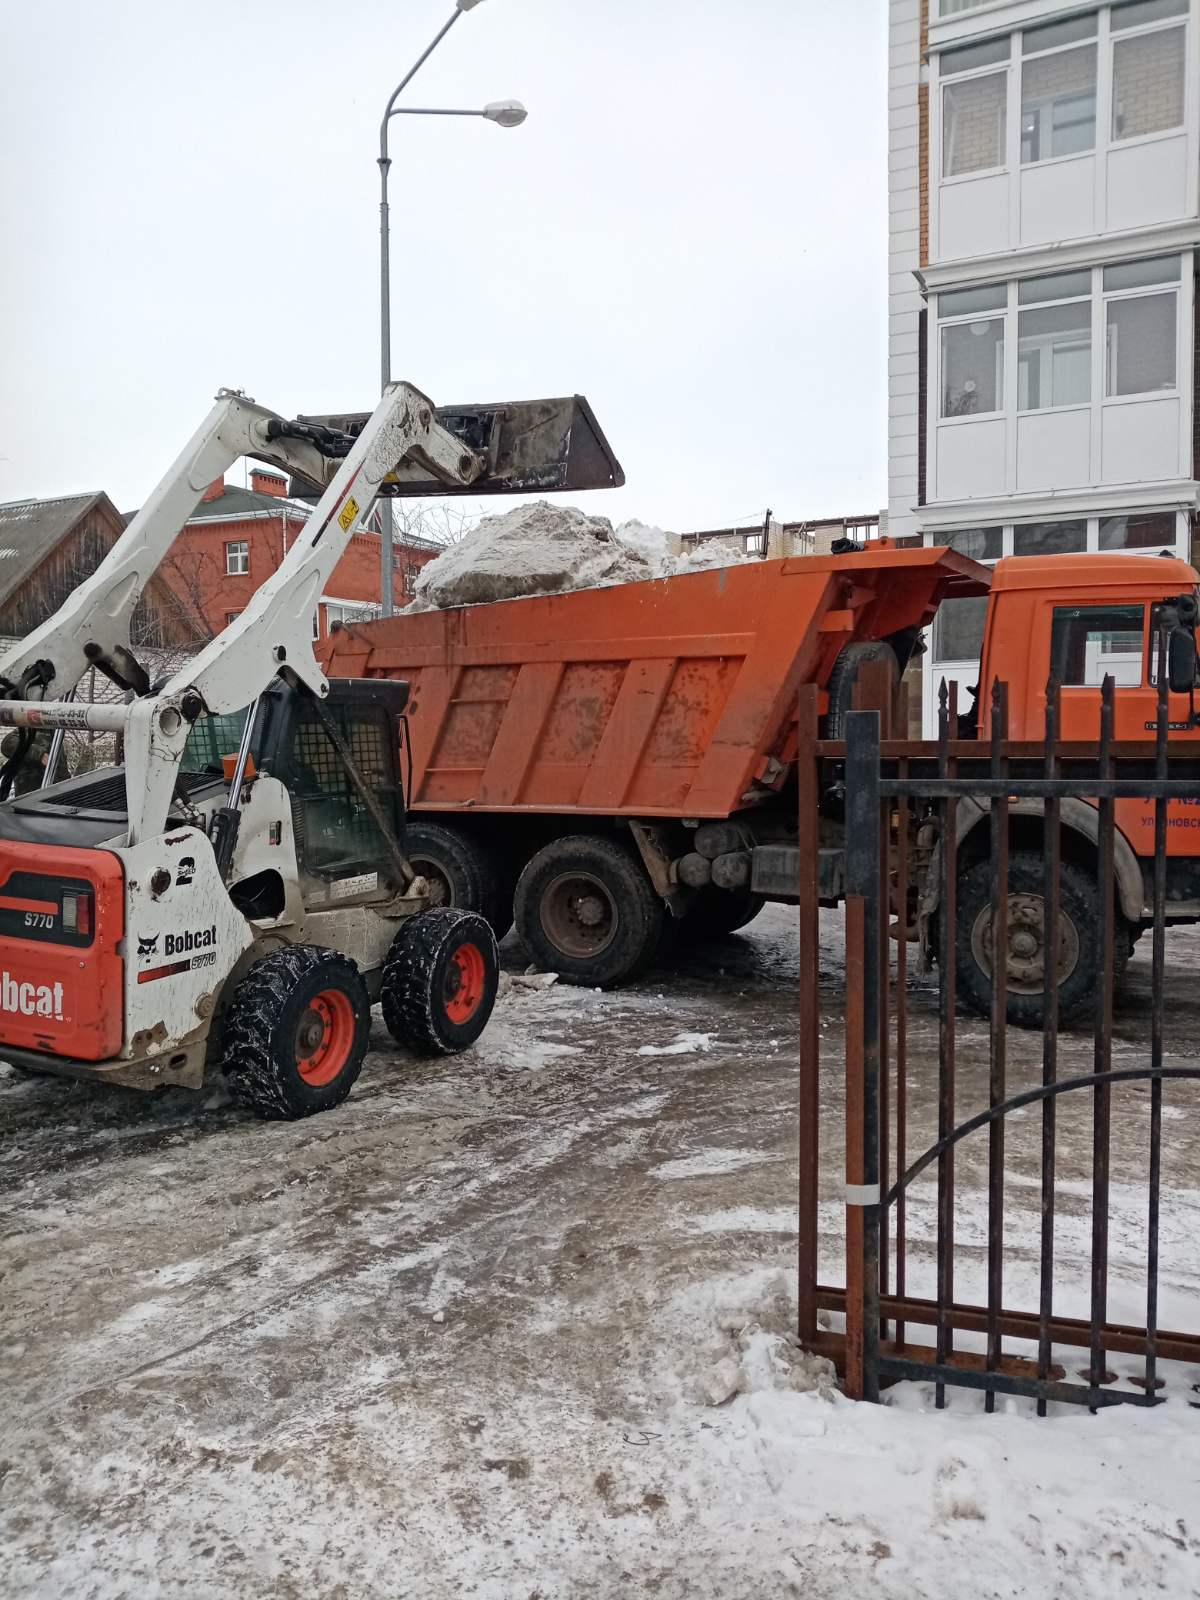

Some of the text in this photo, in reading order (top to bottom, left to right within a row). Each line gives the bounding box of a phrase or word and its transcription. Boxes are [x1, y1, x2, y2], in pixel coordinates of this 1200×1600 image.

[1141, 816, 1200, 828] УЛНОВС
[24, 912, 54, 929] S770
[165, 925, 216, 956] Bobcat
[192, 952, 216, 969] S770
[0, 971, 64, 1021] bcat
